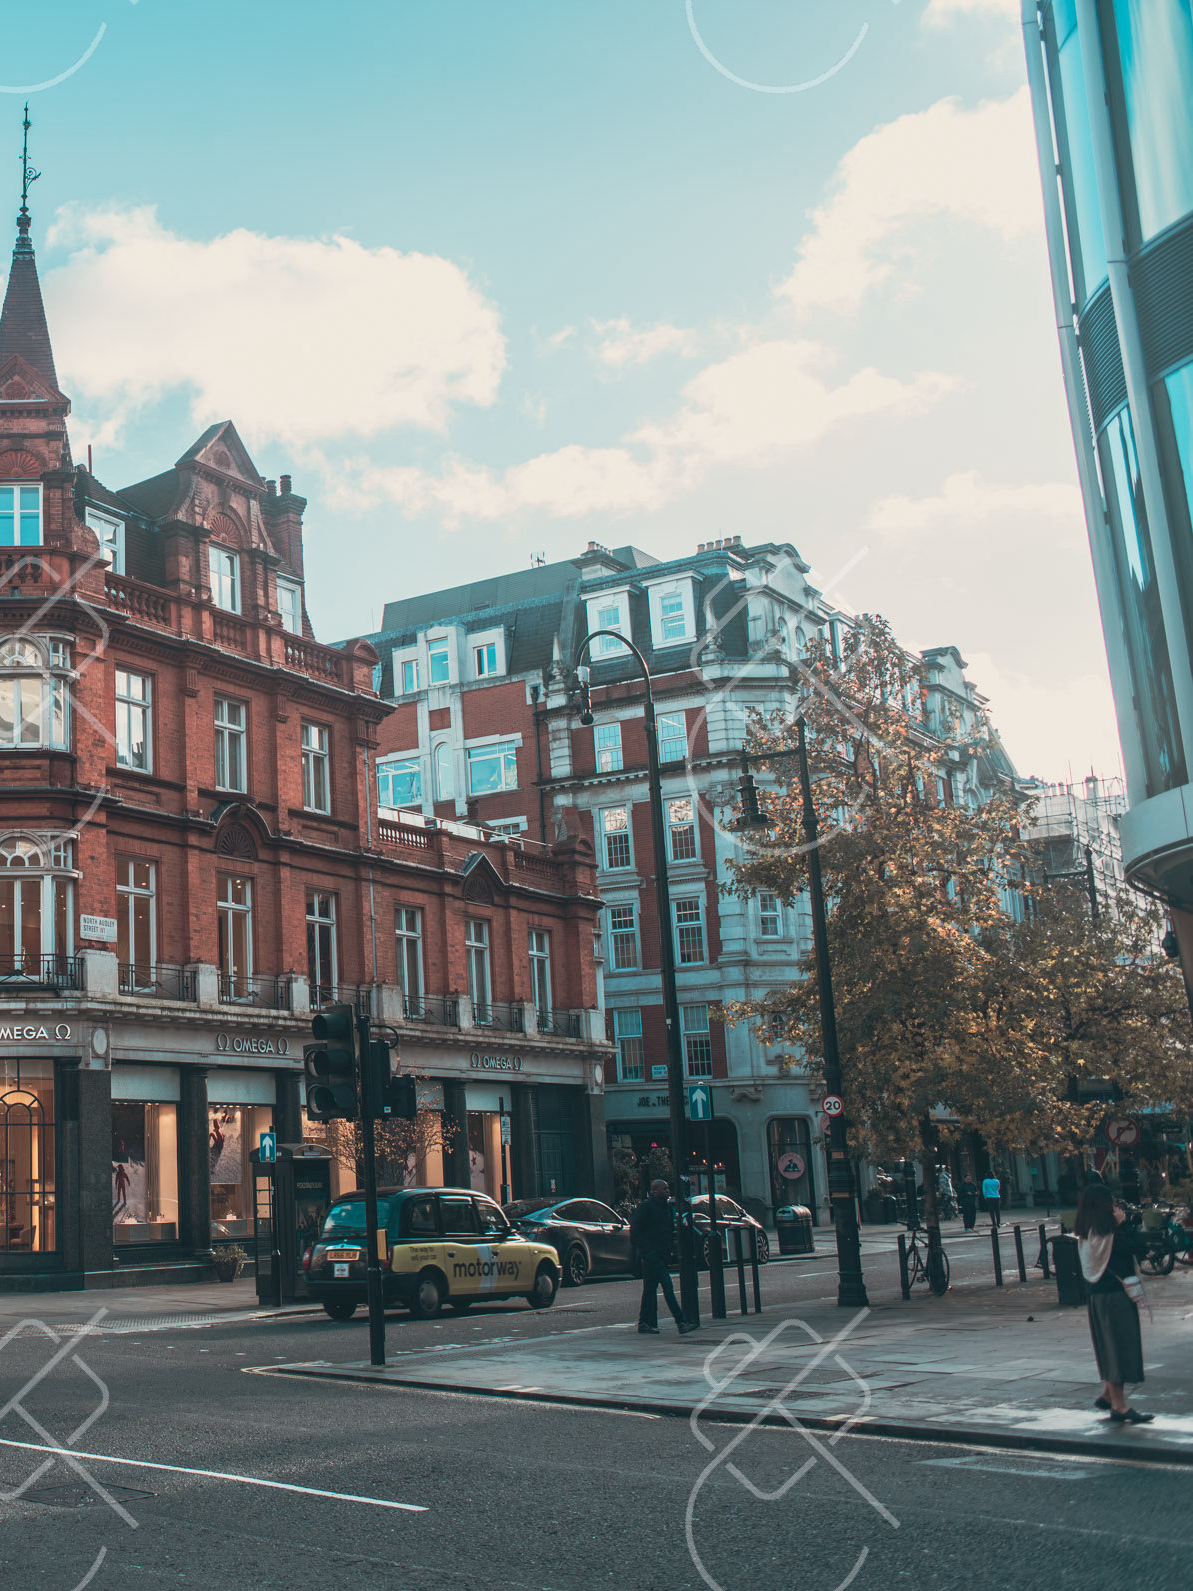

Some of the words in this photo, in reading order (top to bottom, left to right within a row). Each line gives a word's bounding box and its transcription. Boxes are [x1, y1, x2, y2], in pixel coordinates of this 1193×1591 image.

[83, 917, 97, 925] NORTH
[99, 919, 114, 928] AUDLEY
[83, 925, 98, 933] STREET
[233, 1037, 275, 1054] OMEGA
[483, 1055, 513, 1070] OMEGA
[638, 1096, 650, 1107] JOE
[825, 1101, 841, 1110] 20
[453, 1258, 520, 1281] motorway
